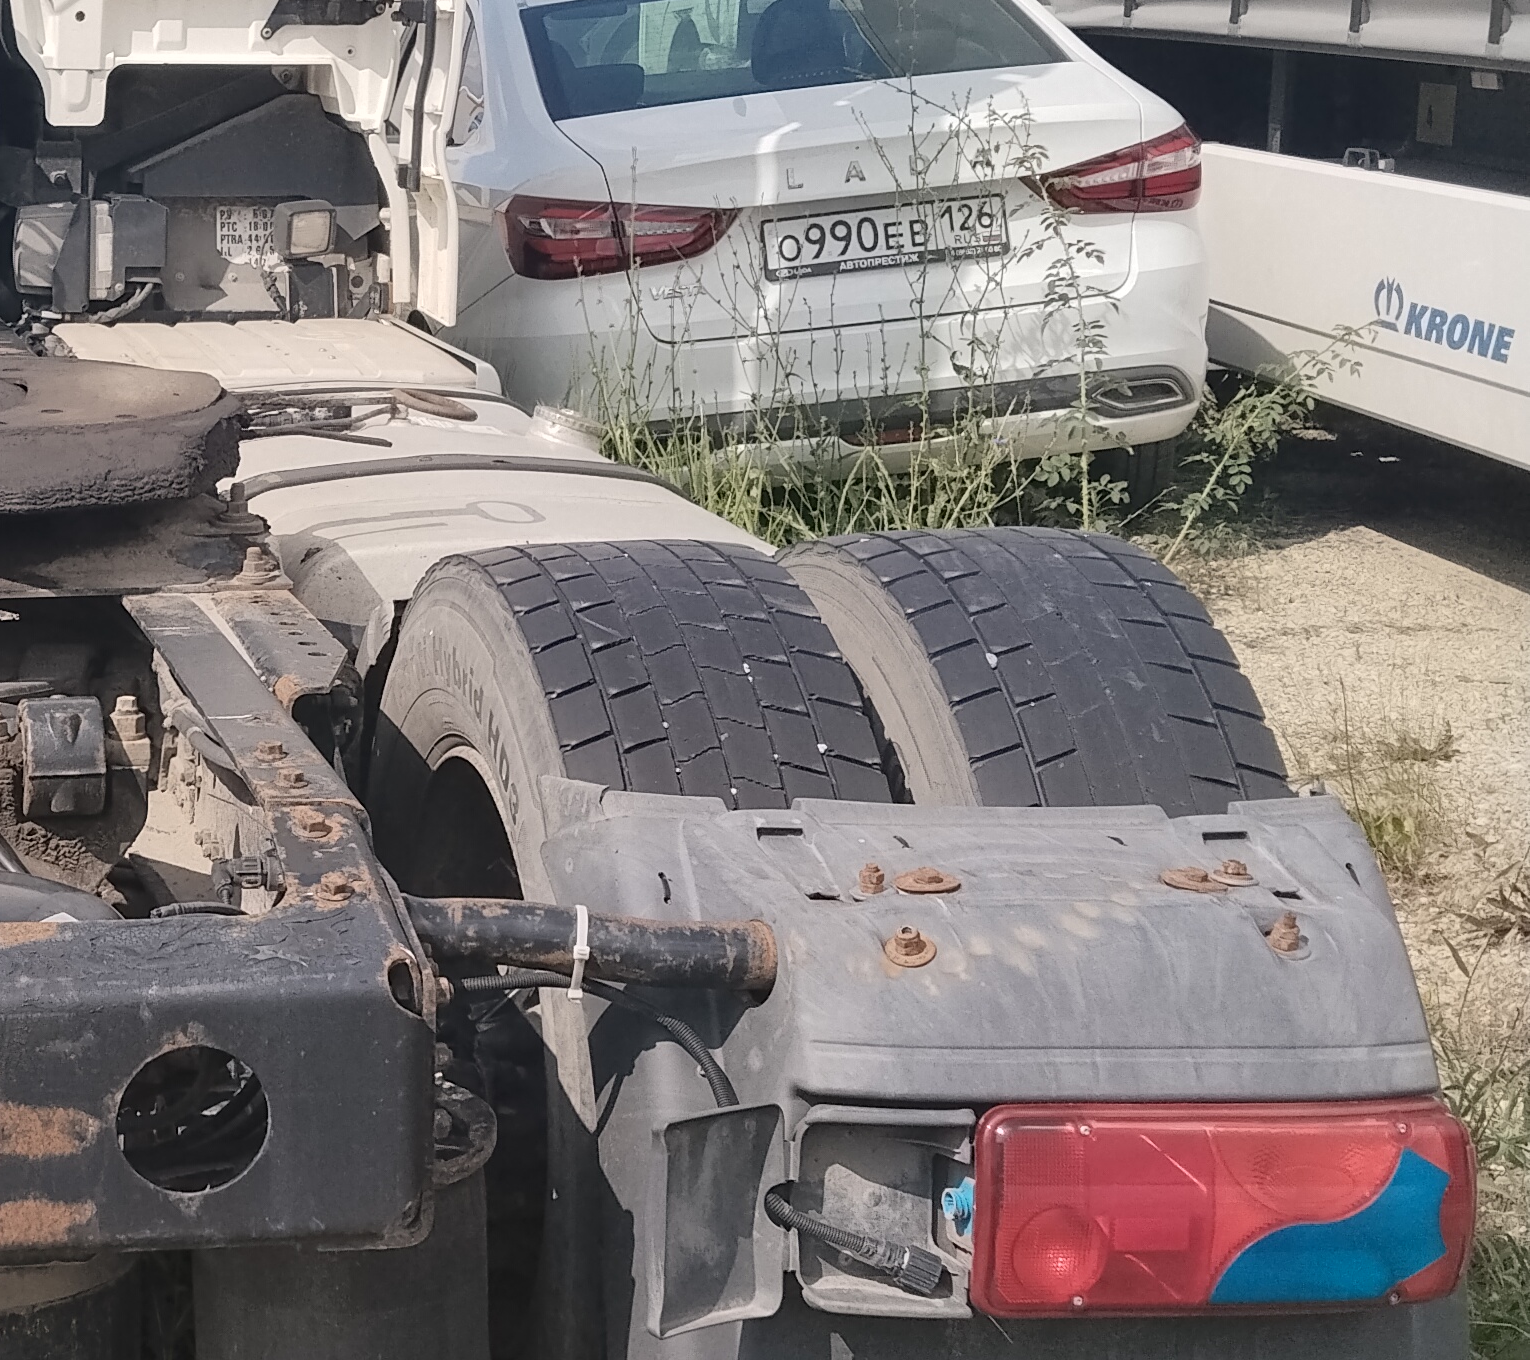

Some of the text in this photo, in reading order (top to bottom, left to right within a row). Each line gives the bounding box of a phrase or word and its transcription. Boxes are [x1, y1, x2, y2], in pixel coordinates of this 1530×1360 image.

[220, 221, 238, 232] PTC
[940, 201, 995, 233] 126
[220, 234, 243, 245] PTRA
[839, 252, 920, 272] АВТОПРЕСТИЖ
[1403, 301, 1516, 364] KRONE
